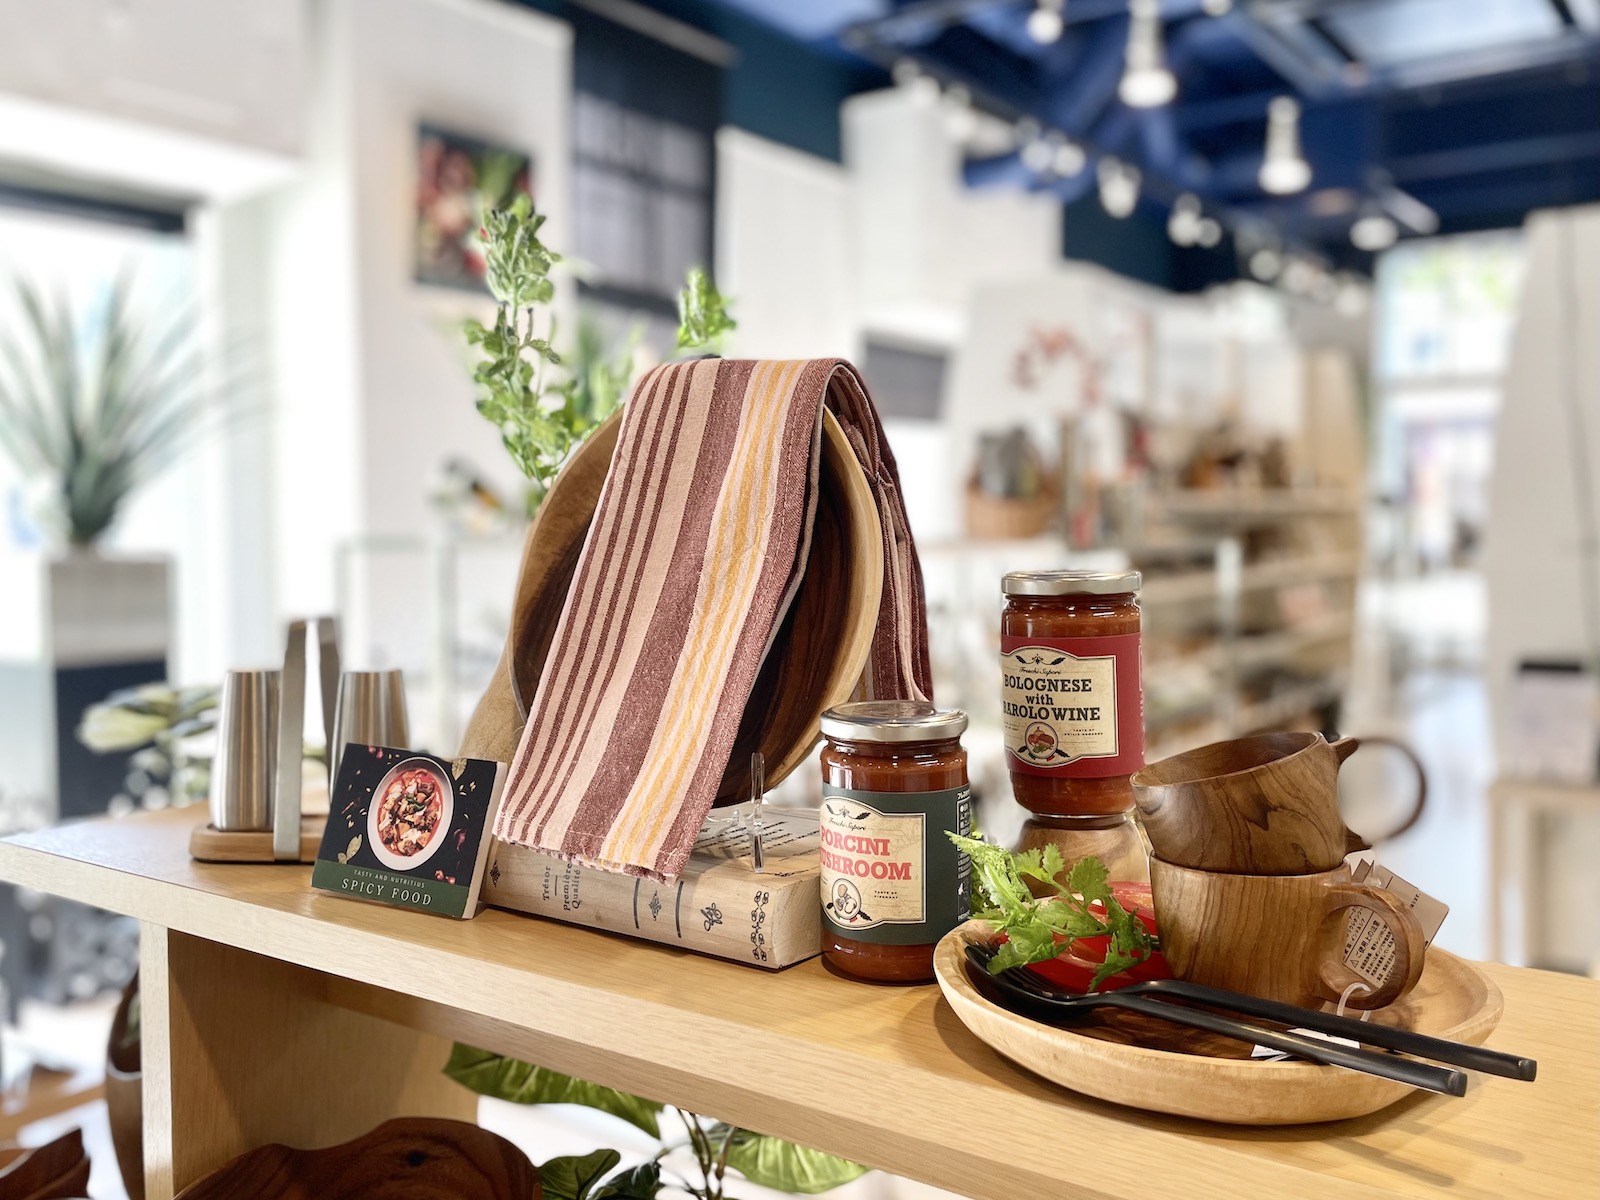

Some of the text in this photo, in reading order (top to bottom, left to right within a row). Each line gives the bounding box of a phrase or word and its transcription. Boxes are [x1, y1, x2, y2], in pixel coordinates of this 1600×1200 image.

[1004, 674, 1092, 692] BOLOGNESE
[1026, 694, 1054, 705] with
[1052, 706, 1100, 721] WINE
[821, 825, 890, 856] PORCINI
[354, 869, 372, 877] TASTY
[820, 846, 912, 880] USHROOM
[342, 878, 431, 905] SPICY FOOD
[542, 866, 550, 900] Trésor
[562, 862, 572, 911] Première
[572, 870, 582, 909] Qualité
